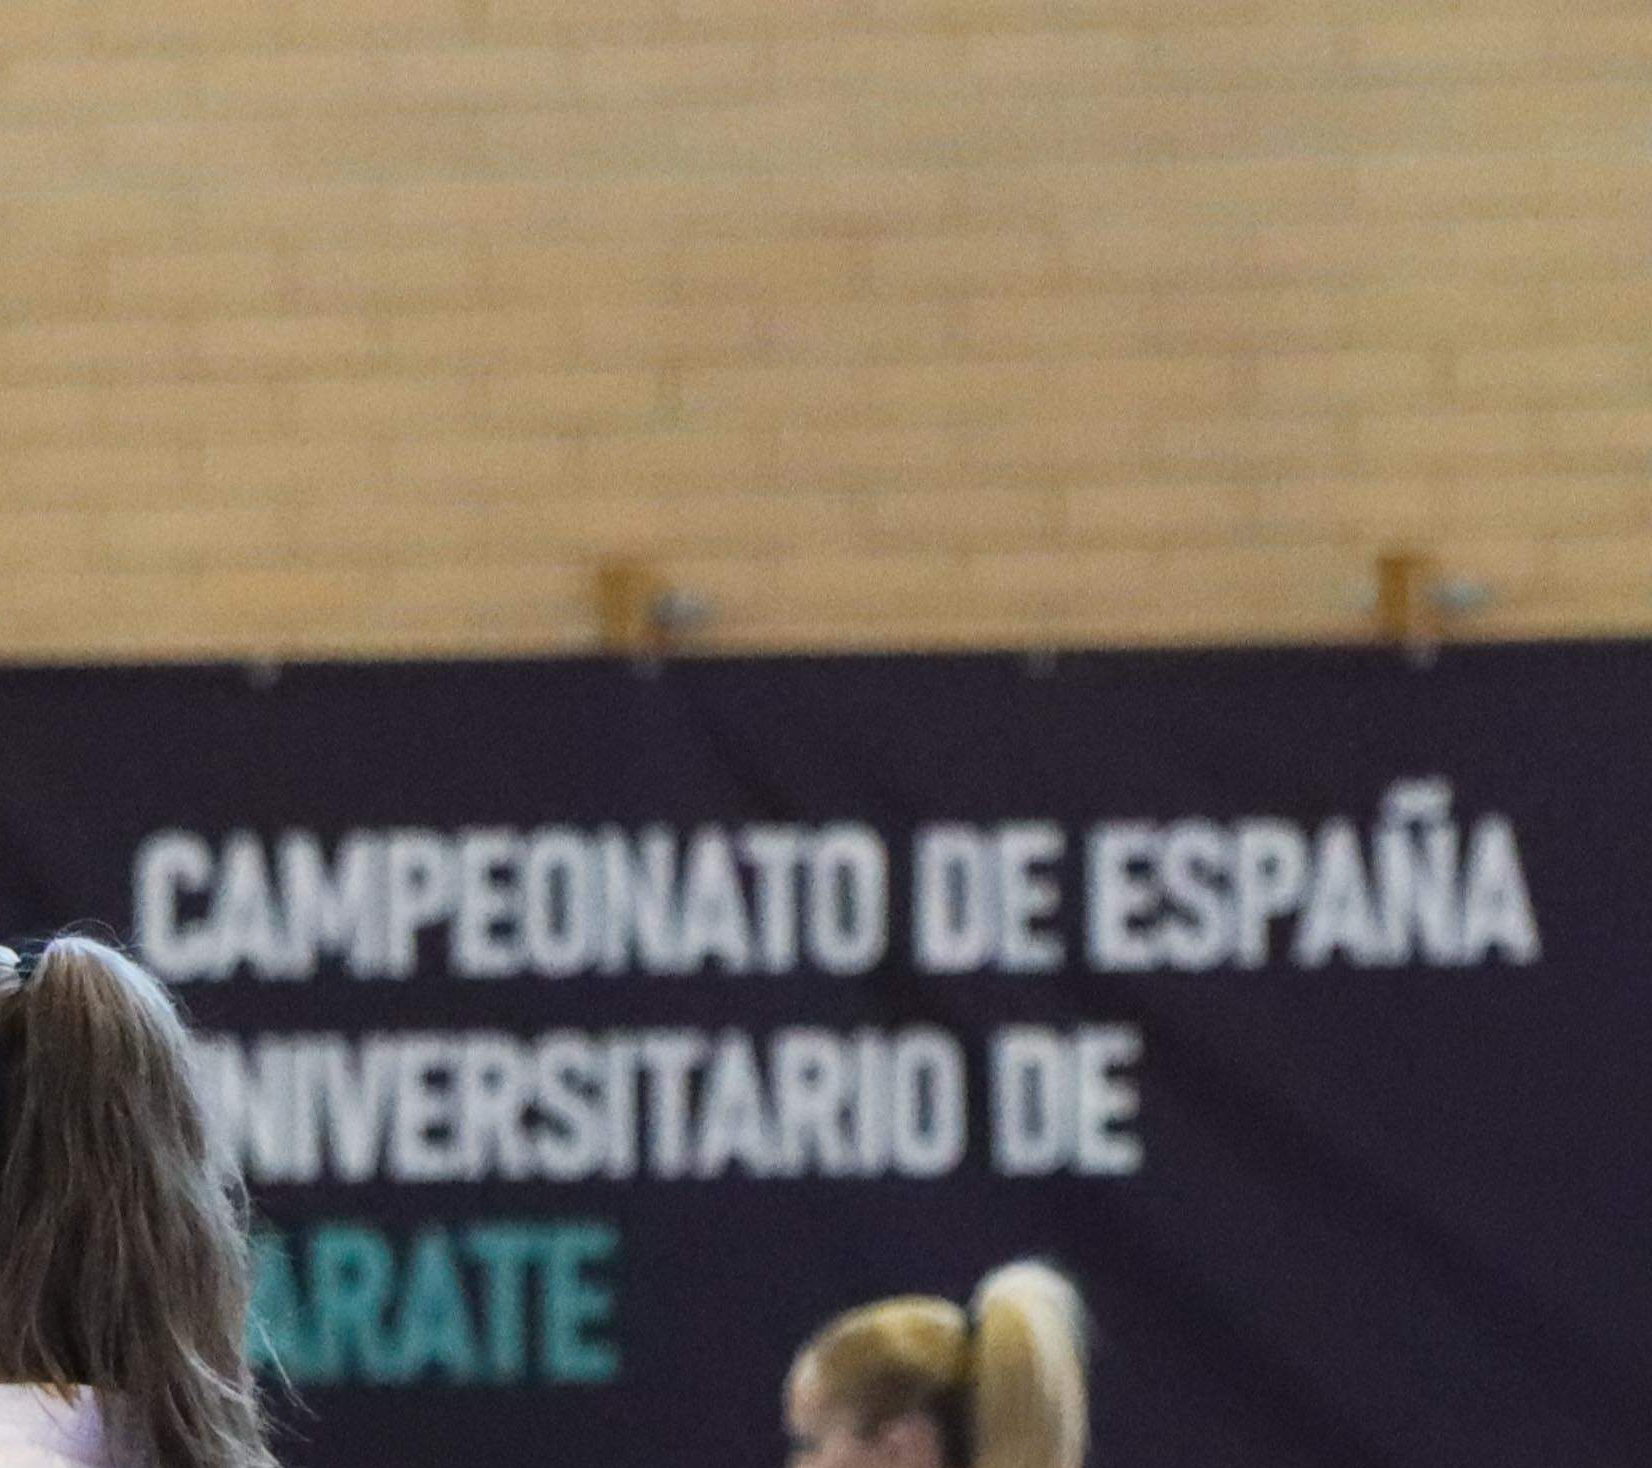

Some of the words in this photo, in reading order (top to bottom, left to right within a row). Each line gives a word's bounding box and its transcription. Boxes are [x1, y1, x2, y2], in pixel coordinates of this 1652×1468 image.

[133, 824, 887, 982] CAMPEONATO
[913, 822, 1063, 972] DE
[1085, 780, 1539, 970] ESPAÑA
[990, 1025, 1143, 1175] DE
[245, 1218, 618, 1383] ARATE
